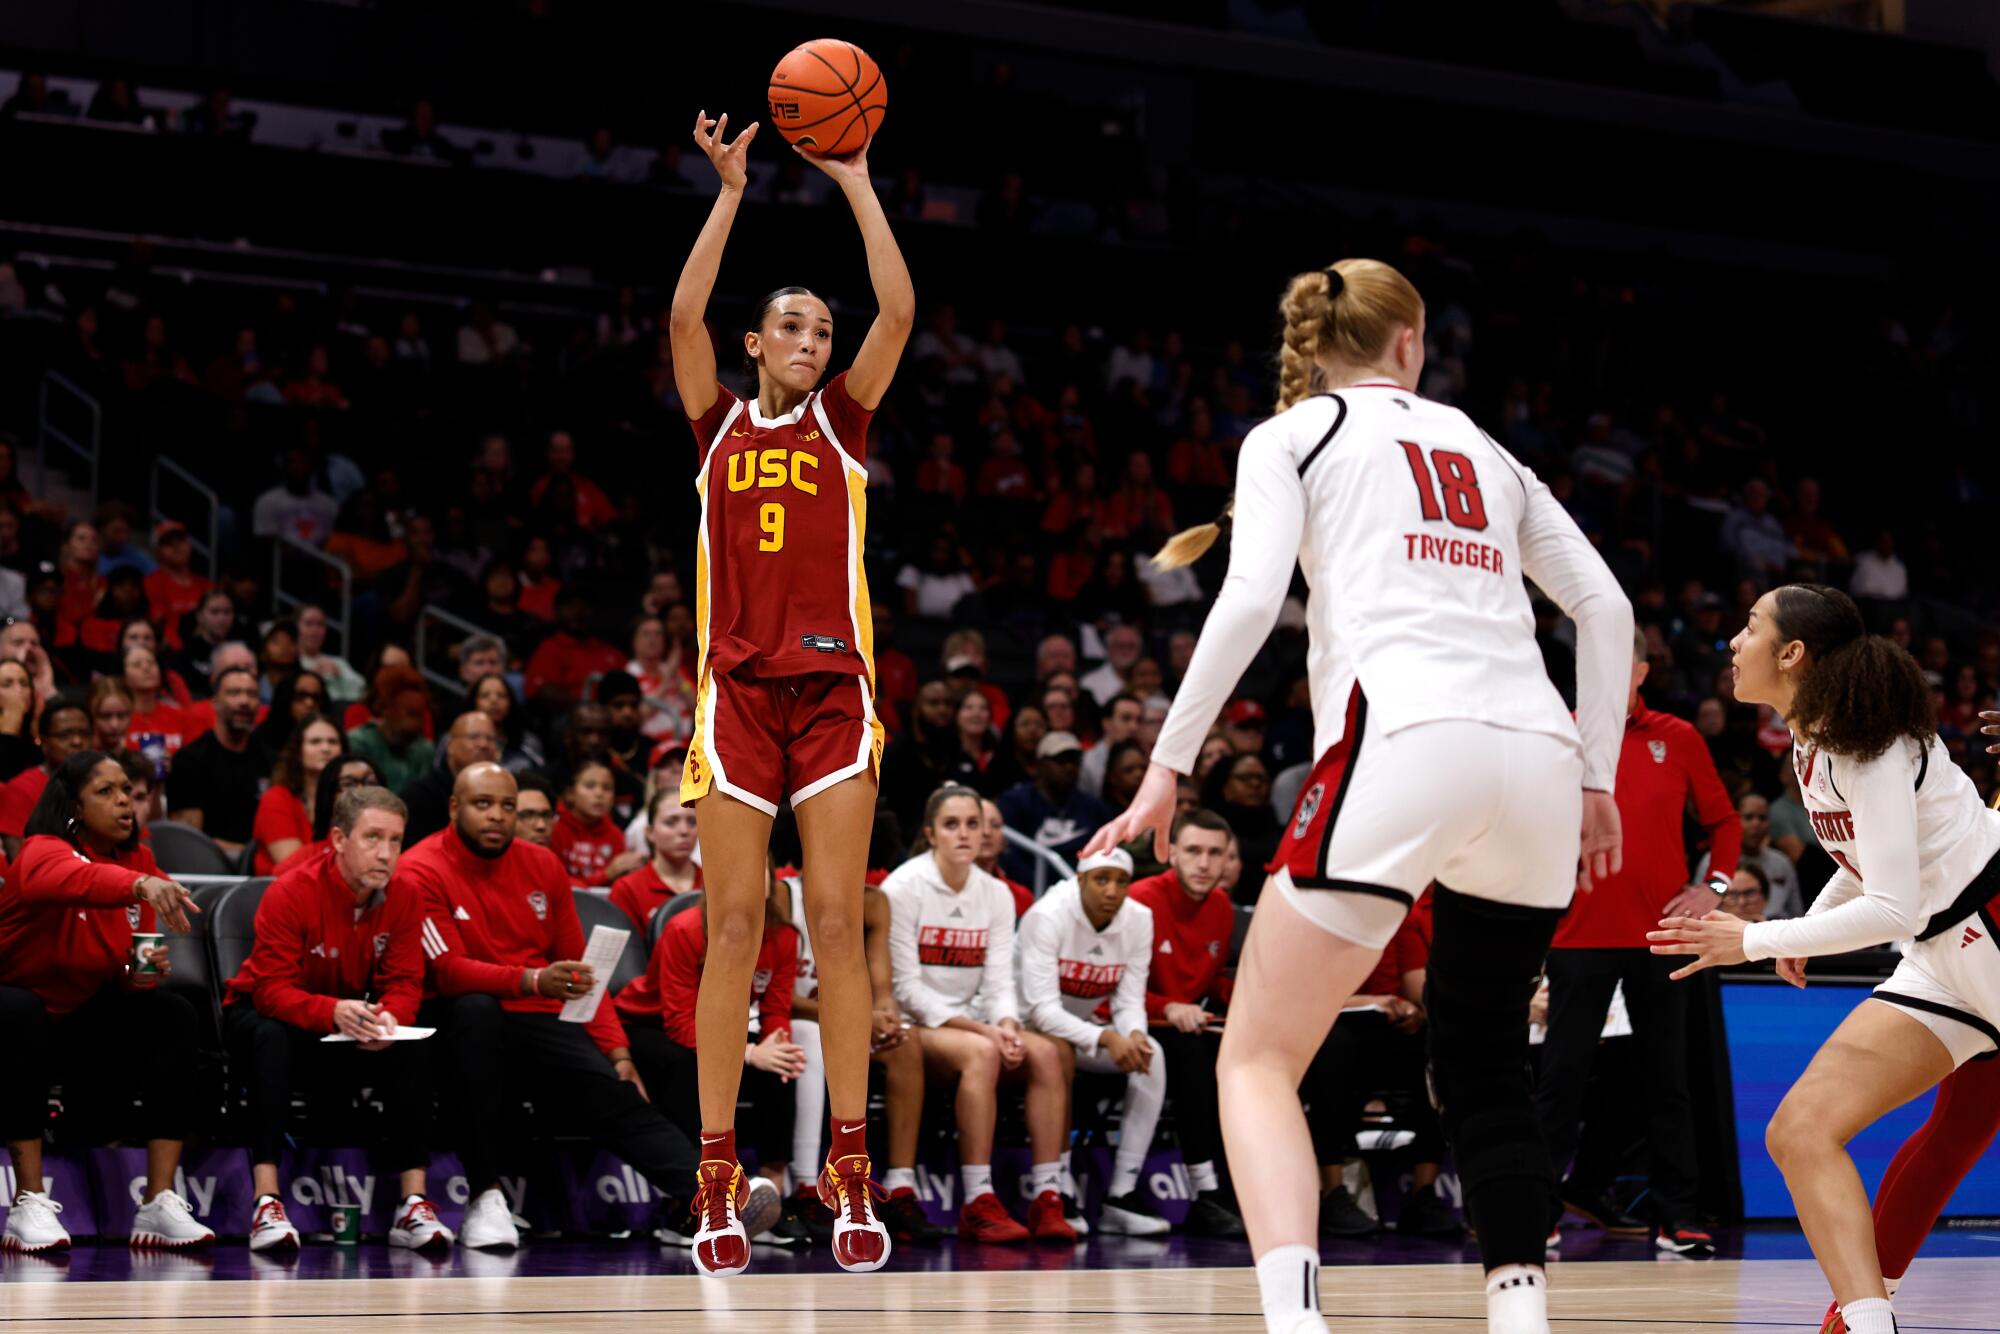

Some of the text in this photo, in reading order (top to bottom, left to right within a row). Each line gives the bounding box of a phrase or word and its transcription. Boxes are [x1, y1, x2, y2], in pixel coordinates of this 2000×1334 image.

[727, 448, 819, 497] USC
[1396, 440, 1488, 532] 18
[758, 502, 785, 553] 9
[1404, 534, 1504, 576] TRYGGER
[1811, 810, 1855, 842] STATE
[922, 928, 988, 948] NC STATE
[129, 1165, 217, 1217] aly
[292, 1165, 376, 1215] ally
[596, 1163, 672, 1204] all
[1150, 1162, 1199, 1202] all
